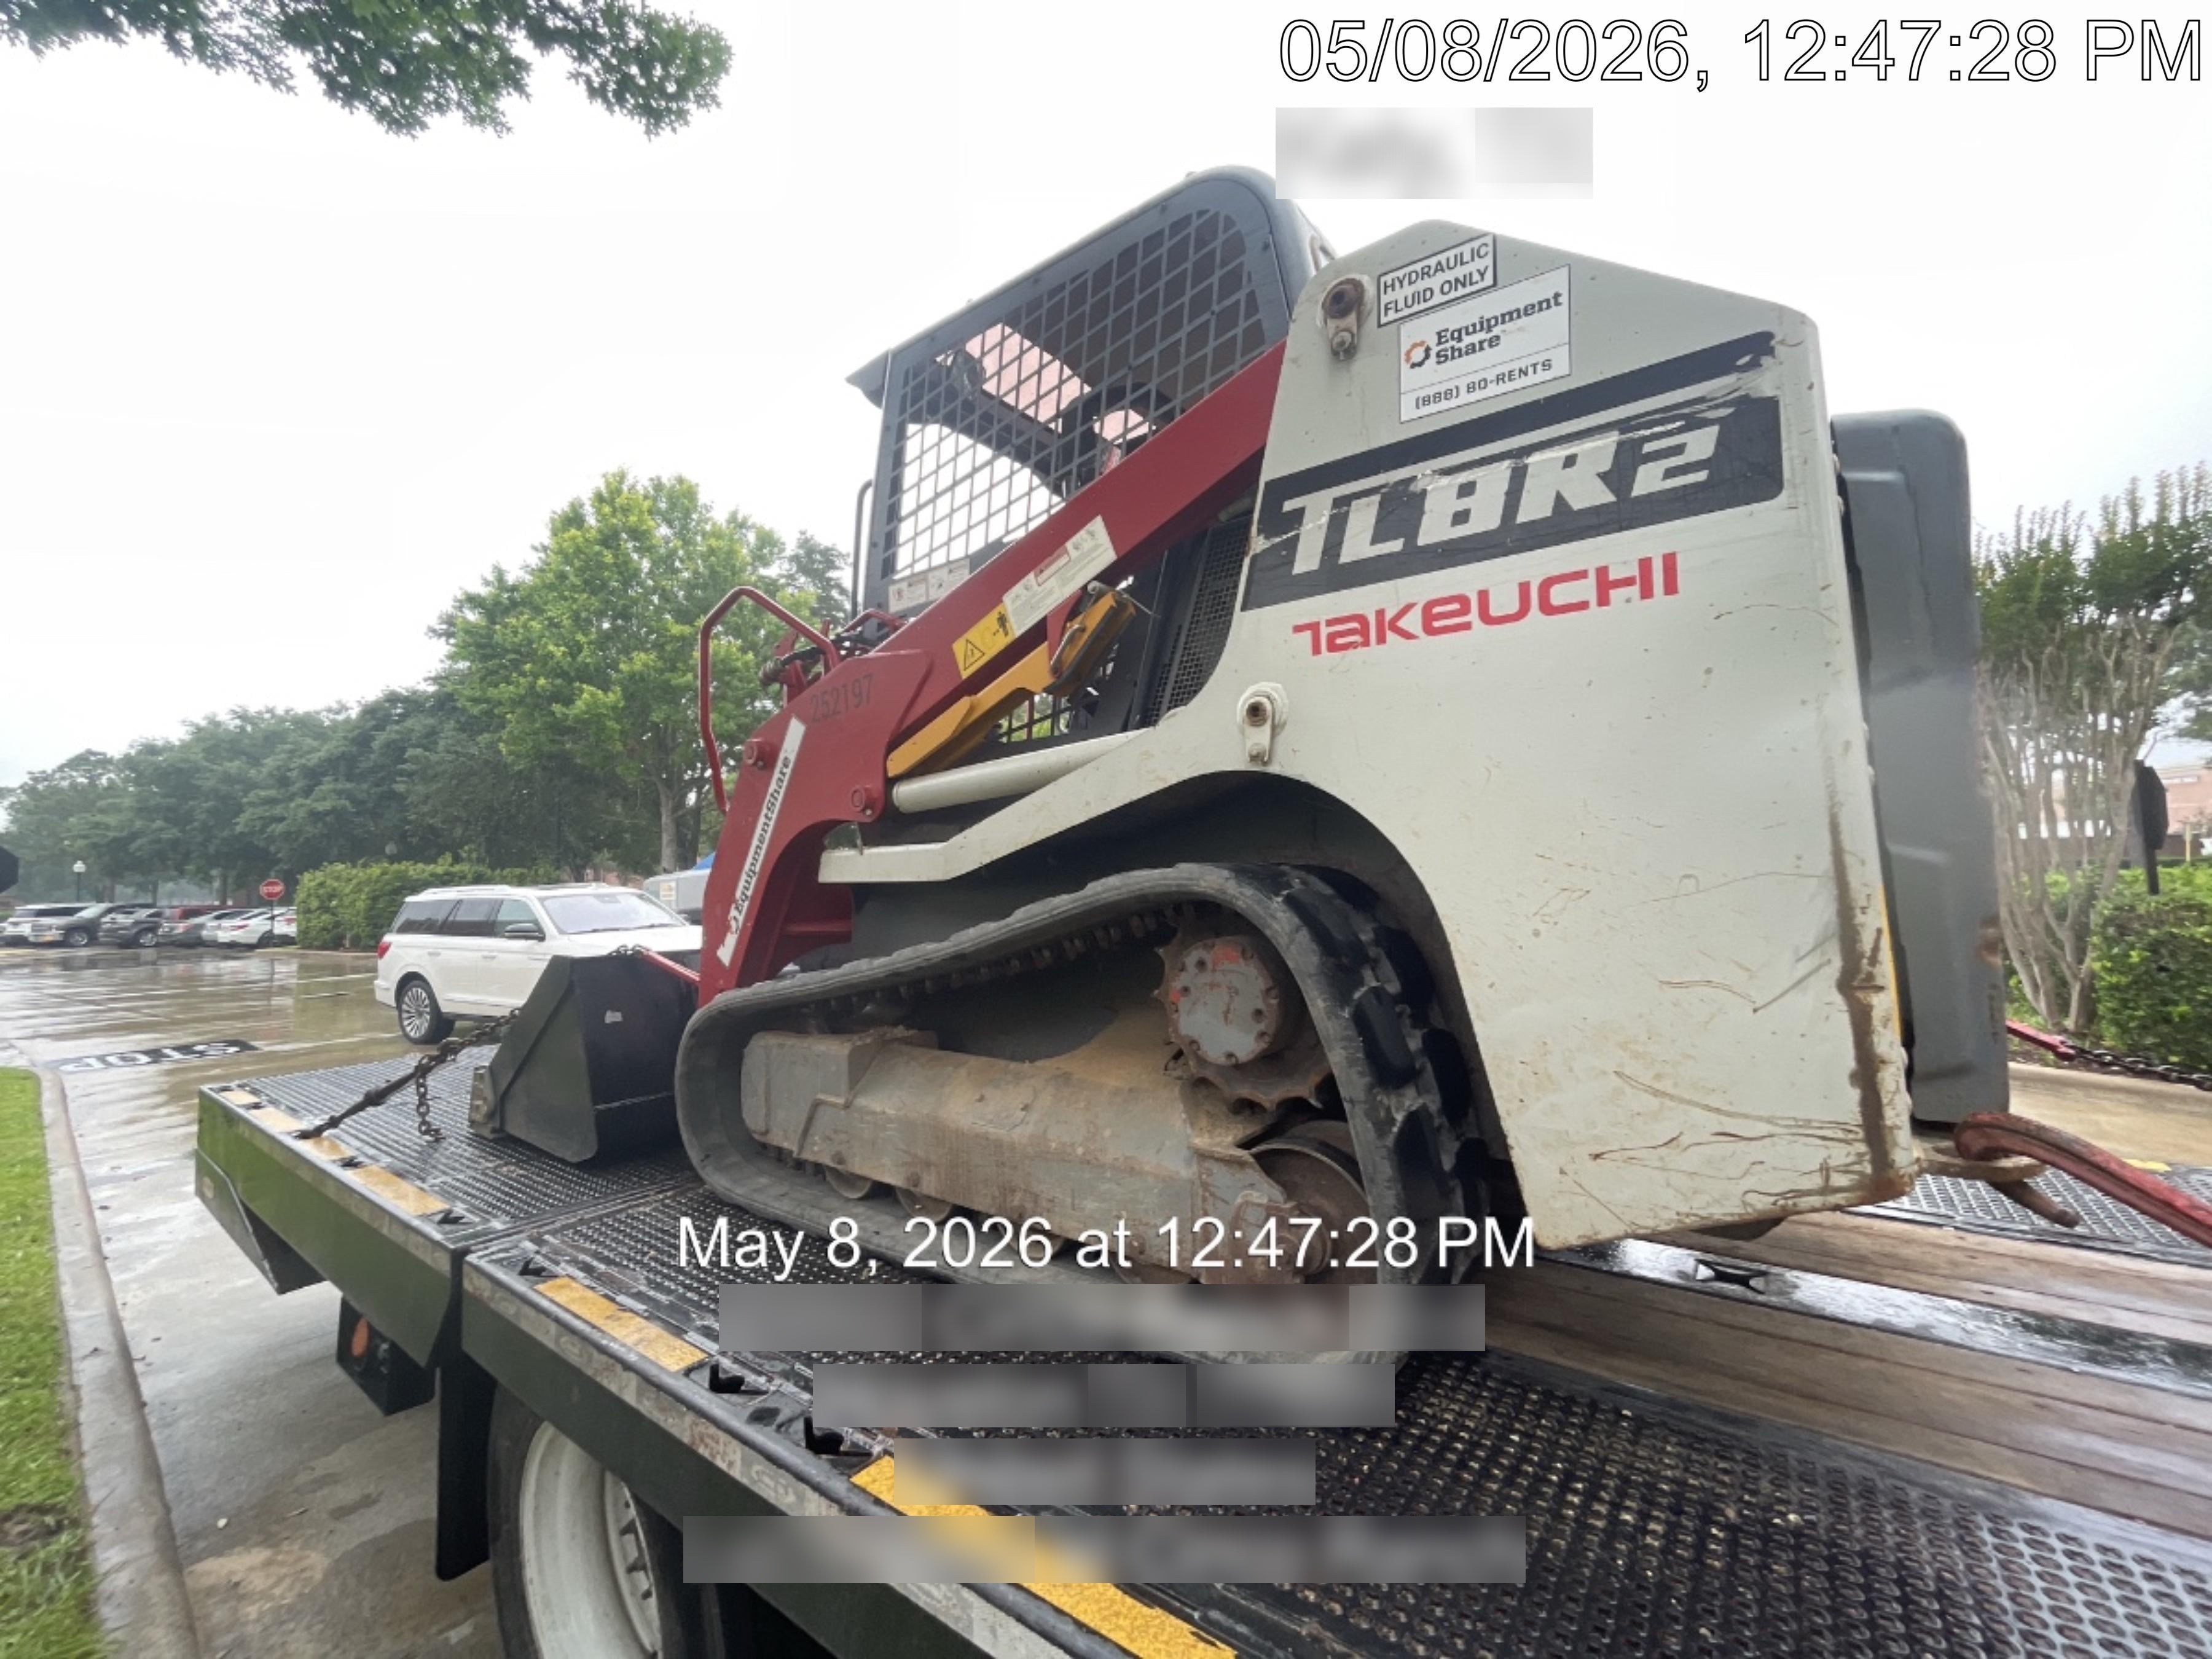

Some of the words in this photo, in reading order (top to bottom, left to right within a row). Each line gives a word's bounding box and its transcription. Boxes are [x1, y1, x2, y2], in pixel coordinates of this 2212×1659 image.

[1383, 243, 1489, 295] HYDRAULIC
[1384, 286, 1434, 318] FLUID
[1440, 265, 1489, 296] ONLY
[1435, 291, 1563, 347] Equipment
[1435, 334, 1501, 366] Share
[1414, 385, 1460, 410] (888)
[1466, 359, 1553, 394] 80-RENTS
[810, 673, 874, 723] 252197
[734, 756, 791, 914] EquipmentShare
[58, 1042, 241, 1072] STOP
